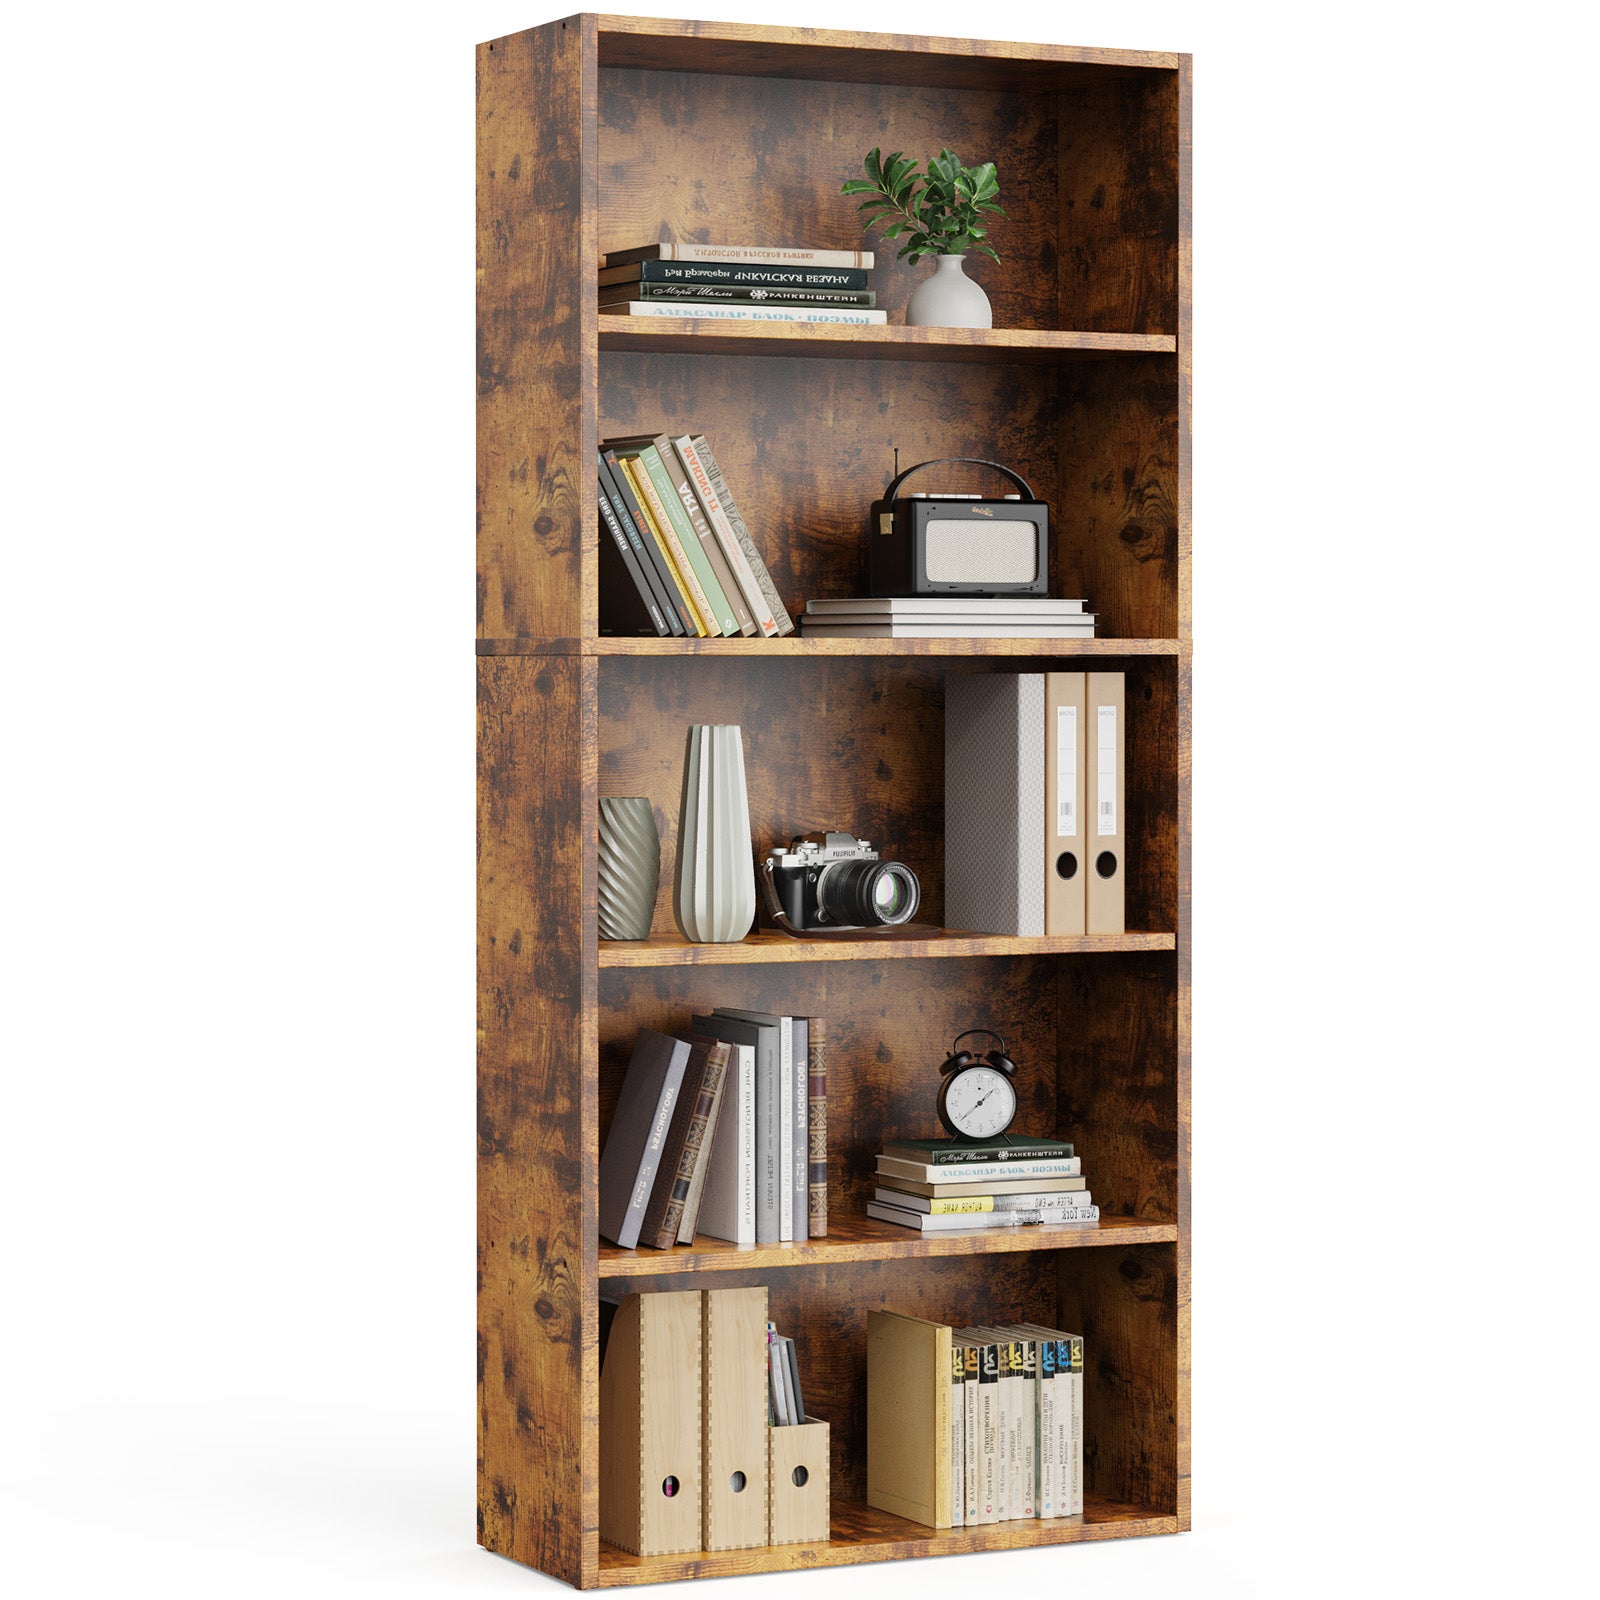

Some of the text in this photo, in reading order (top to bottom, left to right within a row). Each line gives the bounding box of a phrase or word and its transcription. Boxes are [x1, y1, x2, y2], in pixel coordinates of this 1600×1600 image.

[652, 307, 870, 325] АЛЕКСАНДР БЛОК ПОЭМЫ
[832, 850, 856, 858] FUJIFILM
[940, 1164, 1071, 1178] АЛЕКСАНДР БЛОК ПОЭМЫ
